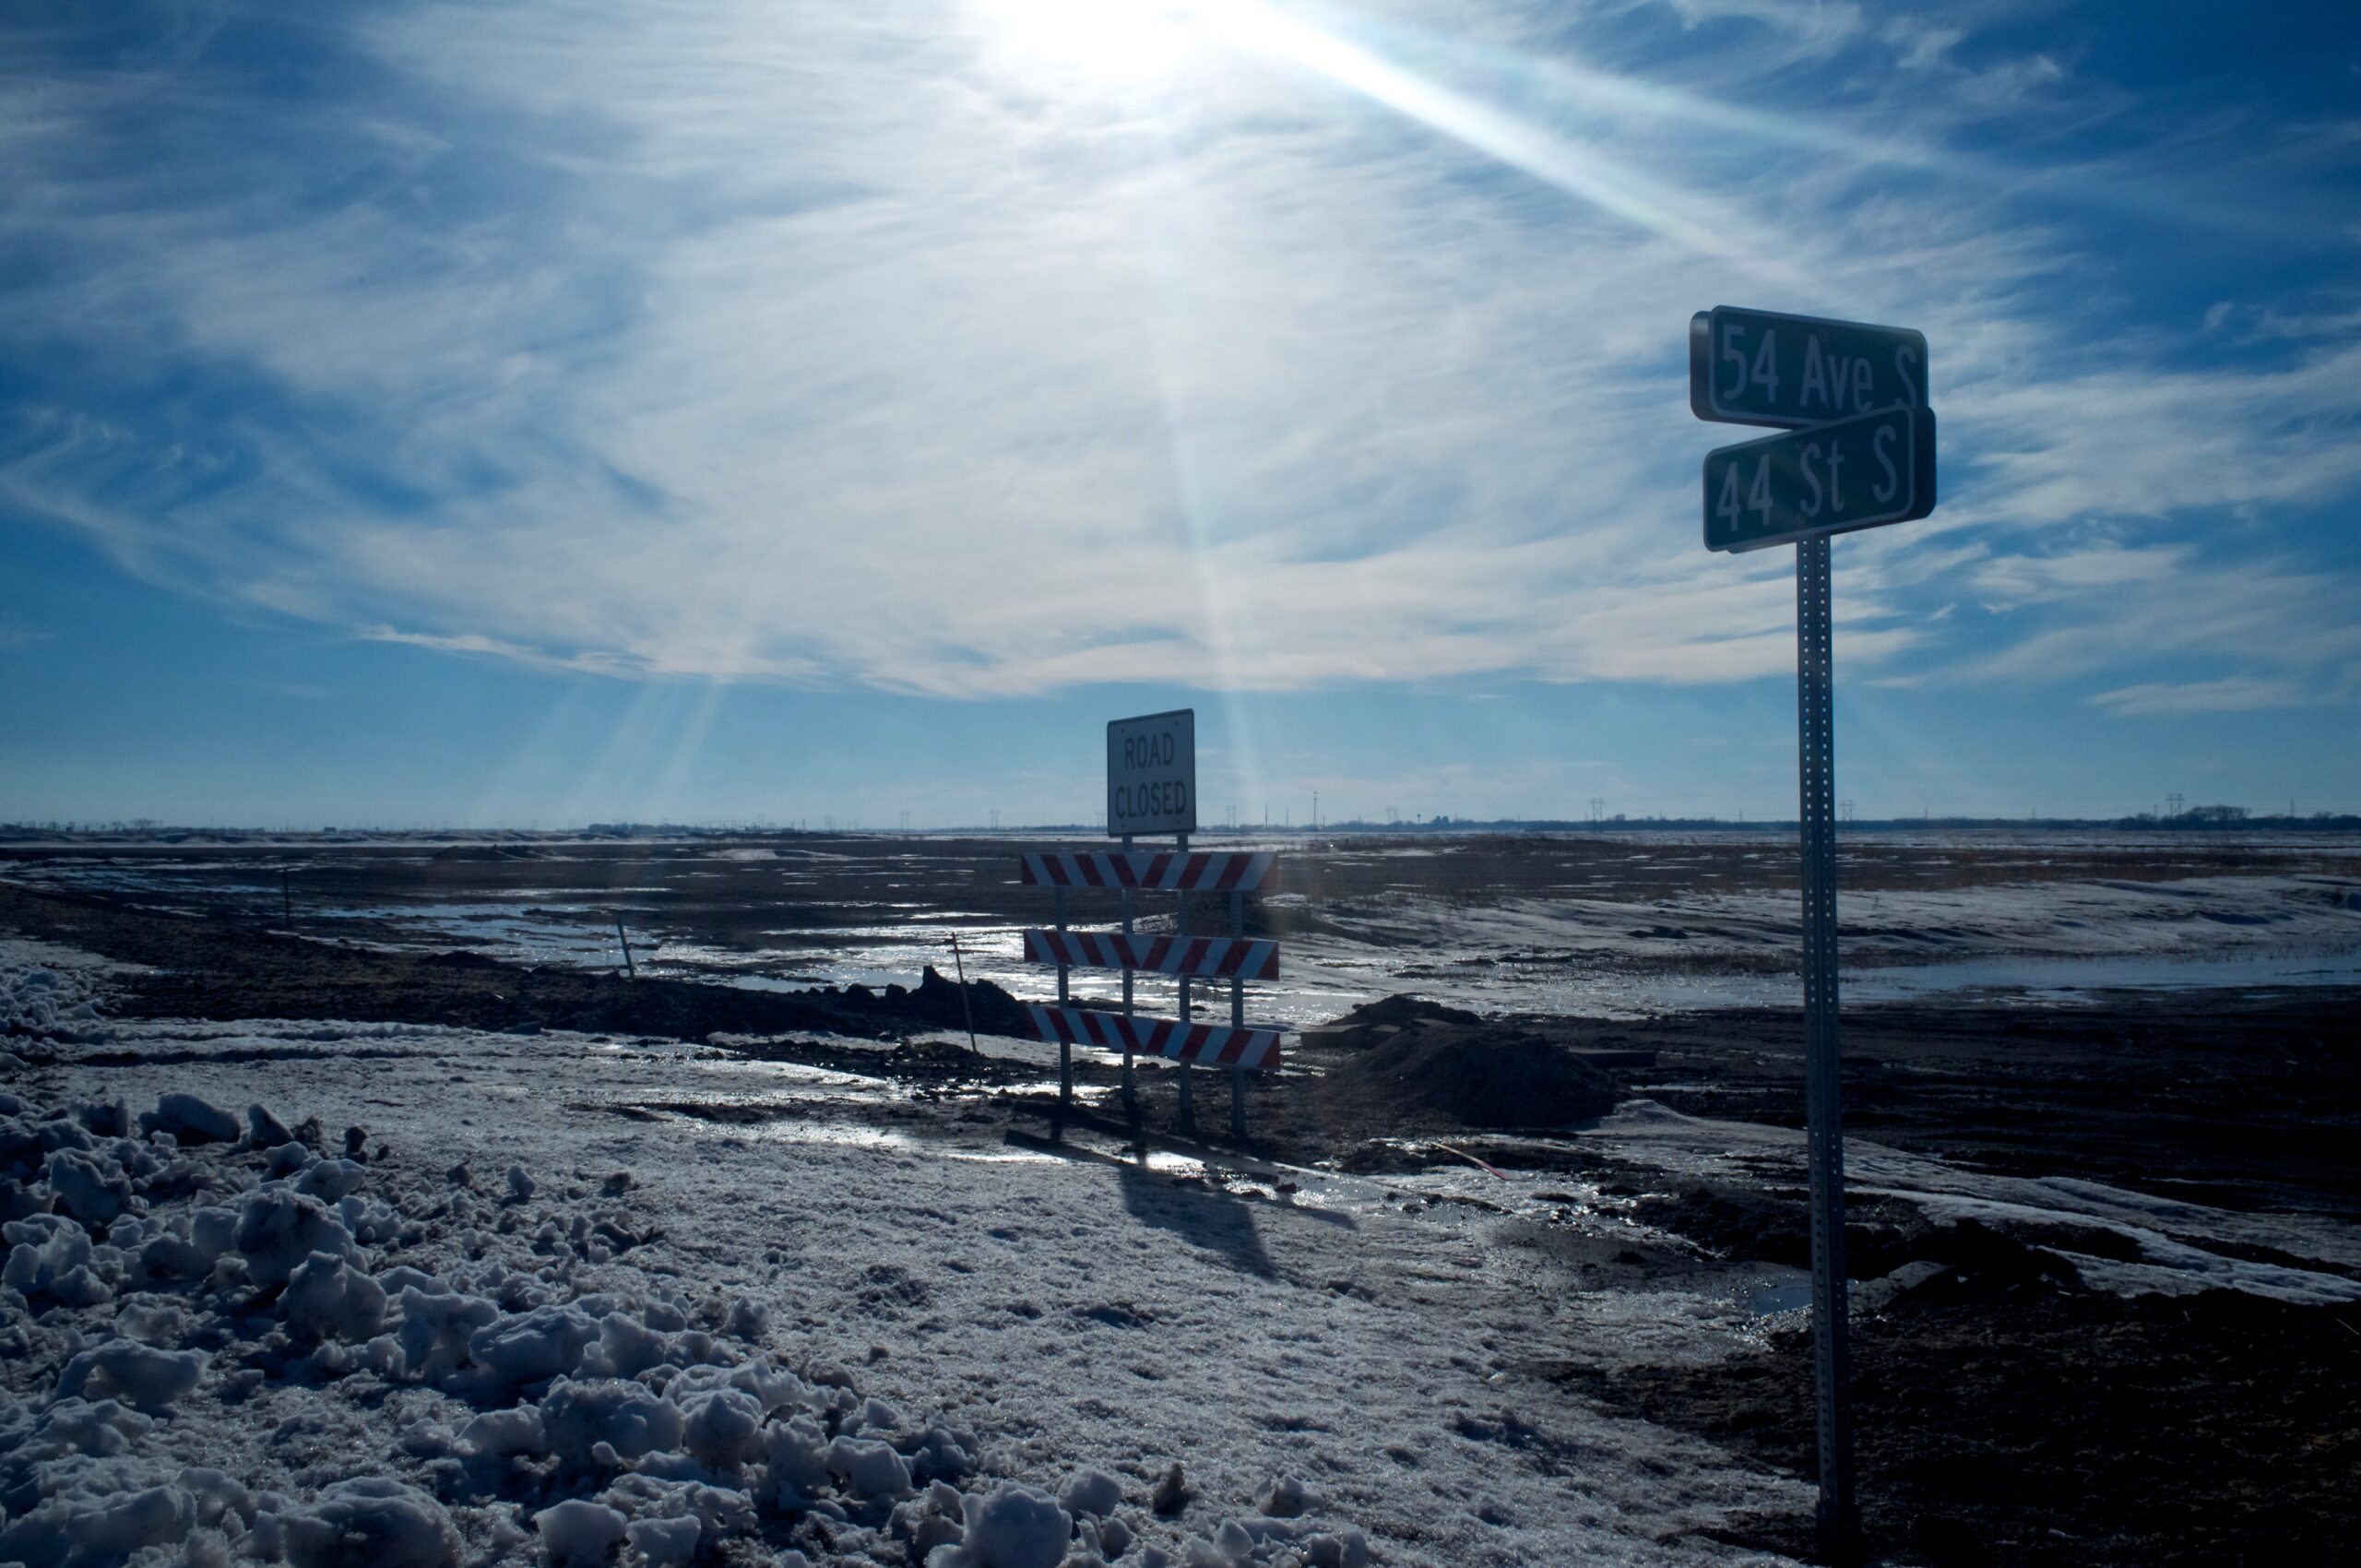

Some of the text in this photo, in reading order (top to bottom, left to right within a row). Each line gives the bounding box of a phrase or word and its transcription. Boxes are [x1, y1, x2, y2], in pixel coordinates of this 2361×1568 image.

[1722, 324, 1918, 413] 54 Ave S
[1716, 424, 1898, 533] 44 St S
[1125, 731, 1174, 771] ROAD
[1115, 780, 1186, 819] CLOSED
